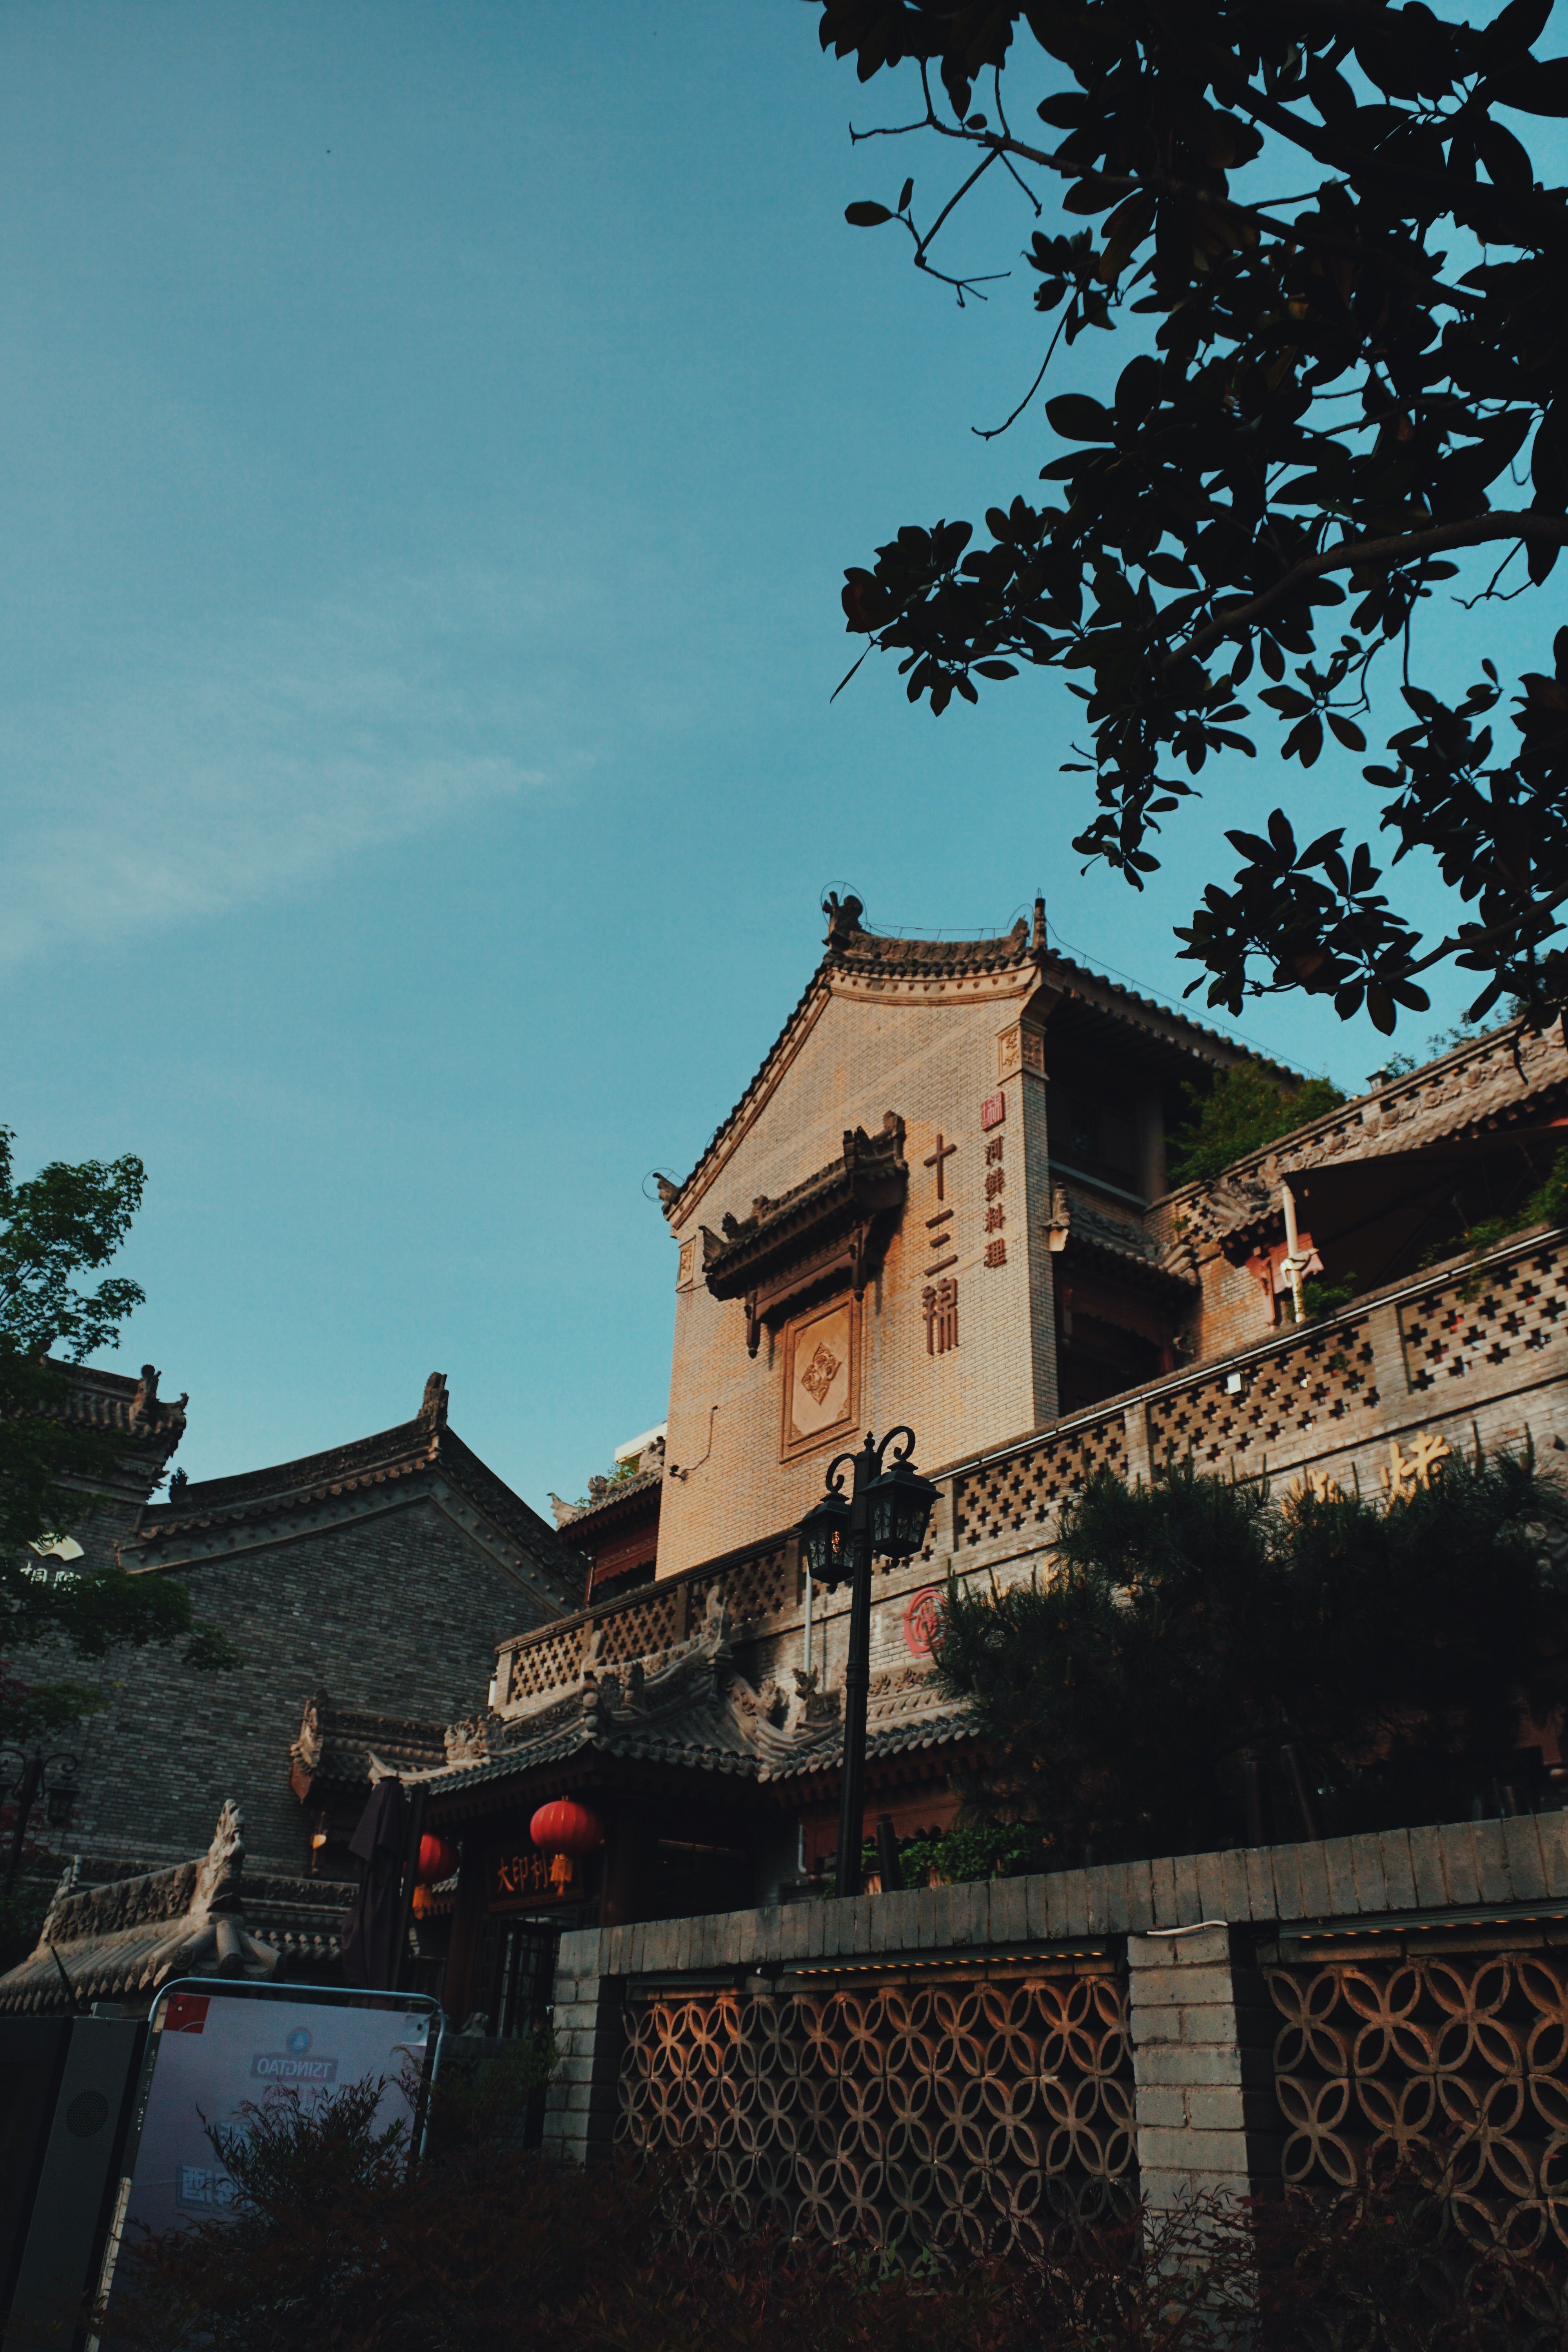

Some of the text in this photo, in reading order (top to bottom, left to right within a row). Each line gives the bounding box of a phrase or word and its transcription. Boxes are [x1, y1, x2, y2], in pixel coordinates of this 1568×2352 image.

[984, 1135, 1007, 1268] 河鮮料理
[497, 1850, 561, 1894] 大印利
